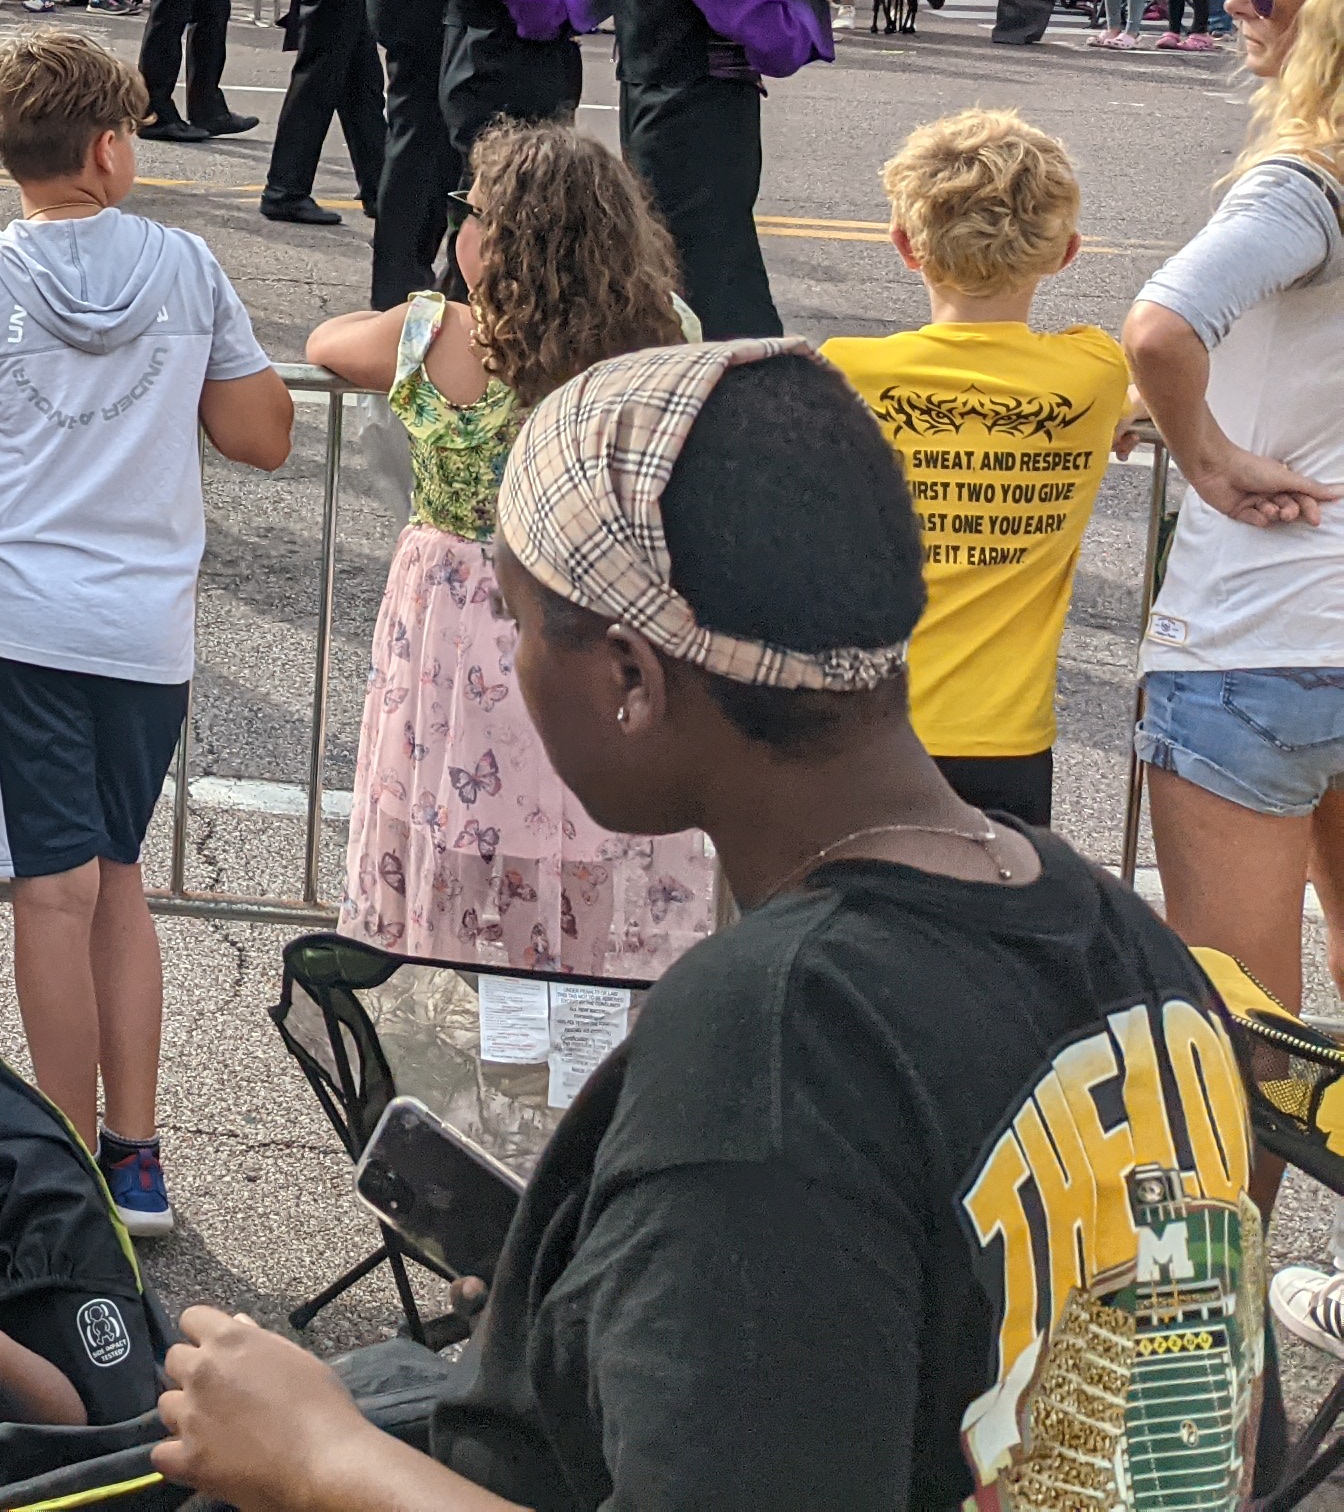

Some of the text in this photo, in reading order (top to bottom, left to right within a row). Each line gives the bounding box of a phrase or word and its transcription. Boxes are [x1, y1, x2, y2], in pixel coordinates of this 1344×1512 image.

[980, 451, 1016, 472] AND
[955, 482, 996, 503] TWO
[1000, 483, 1036, 504] YOU
[951, 514, 983, 534] ONE
[988, 514, 1023, 535] YOU
